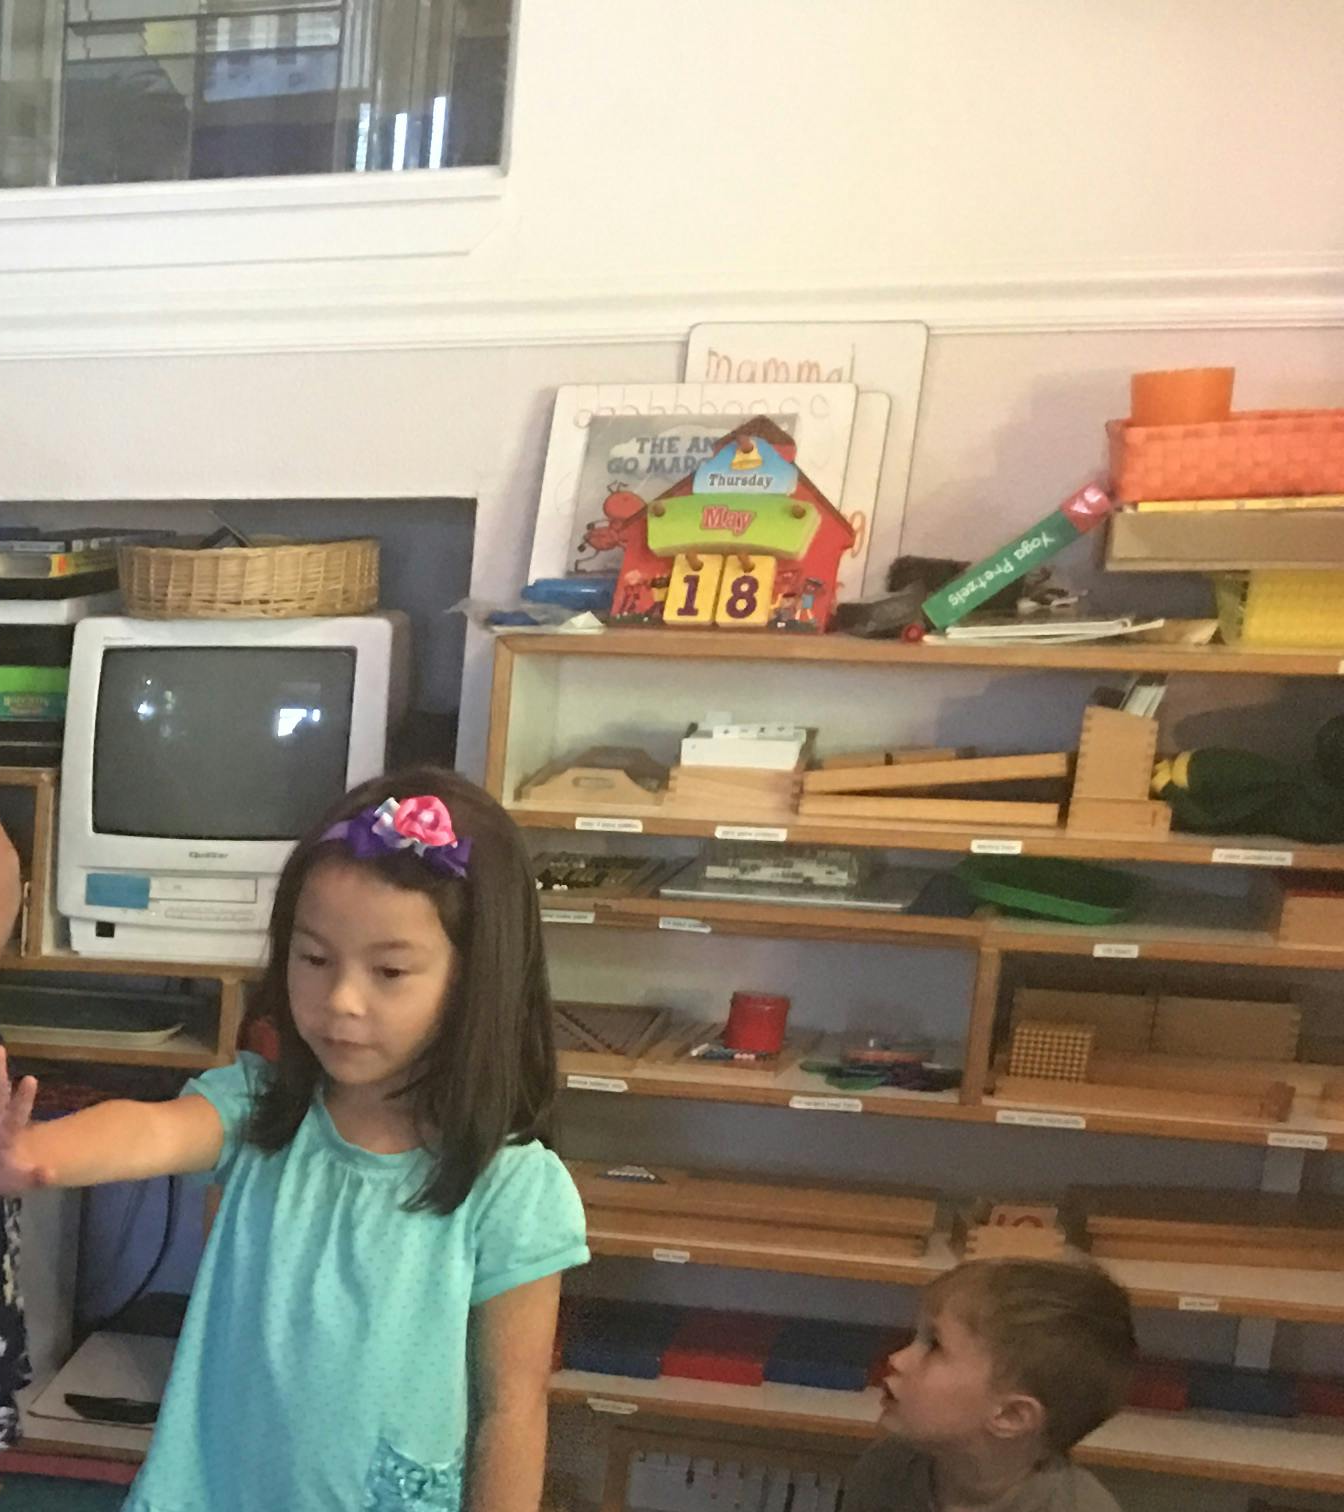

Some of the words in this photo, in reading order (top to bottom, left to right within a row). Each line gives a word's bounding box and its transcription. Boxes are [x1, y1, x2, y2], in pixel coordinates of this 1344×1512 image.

[635, 436, 681, 454] THE
[607, 457, 640, 474] GO
[708, 473, 774, 490] Thursday
[701, 506, 757, 535] May
[1013, 531, 1056, 561] Yoga
[947, 557, 1015, 607] Pretzels
